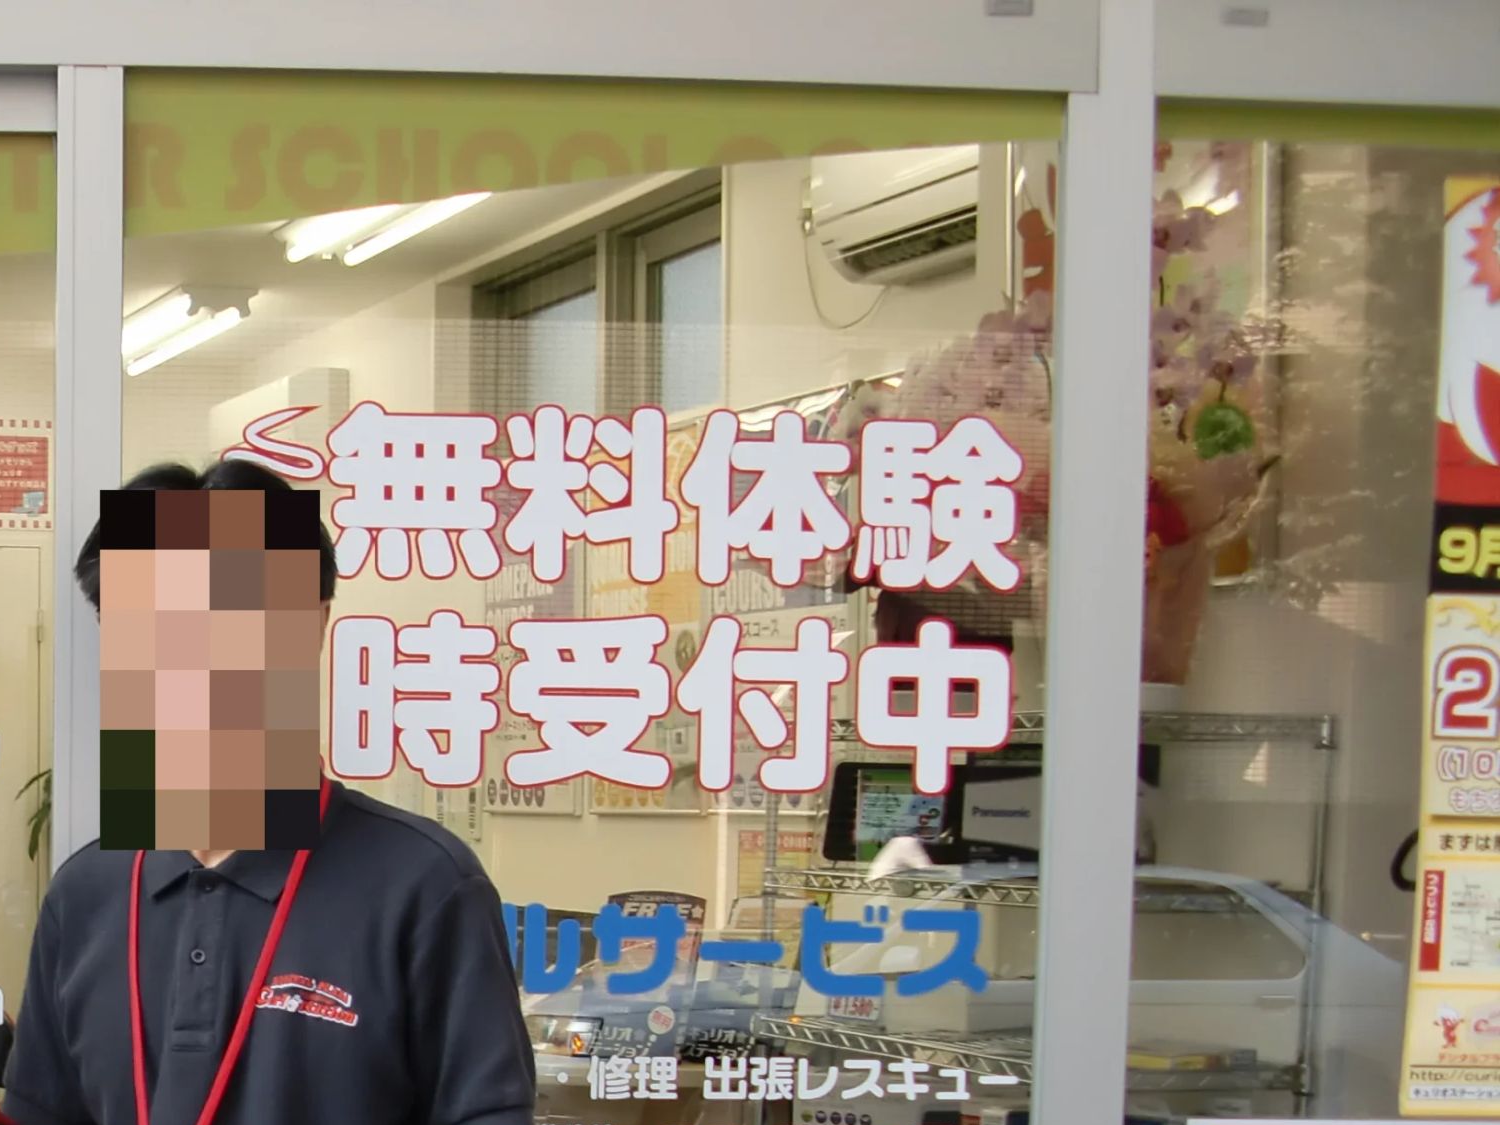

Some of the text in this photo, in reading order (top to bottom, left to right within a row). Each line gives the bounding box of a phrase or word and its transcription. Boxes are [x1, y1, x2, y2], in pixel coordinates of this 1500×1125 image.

[327, 400, 1024, 592] 無料体験
[329, 608, 1015, 795] 時受付中
[622, 902, 693, 918] FRE
[702, 1057, 1020, 1102] 出張レスキュー
